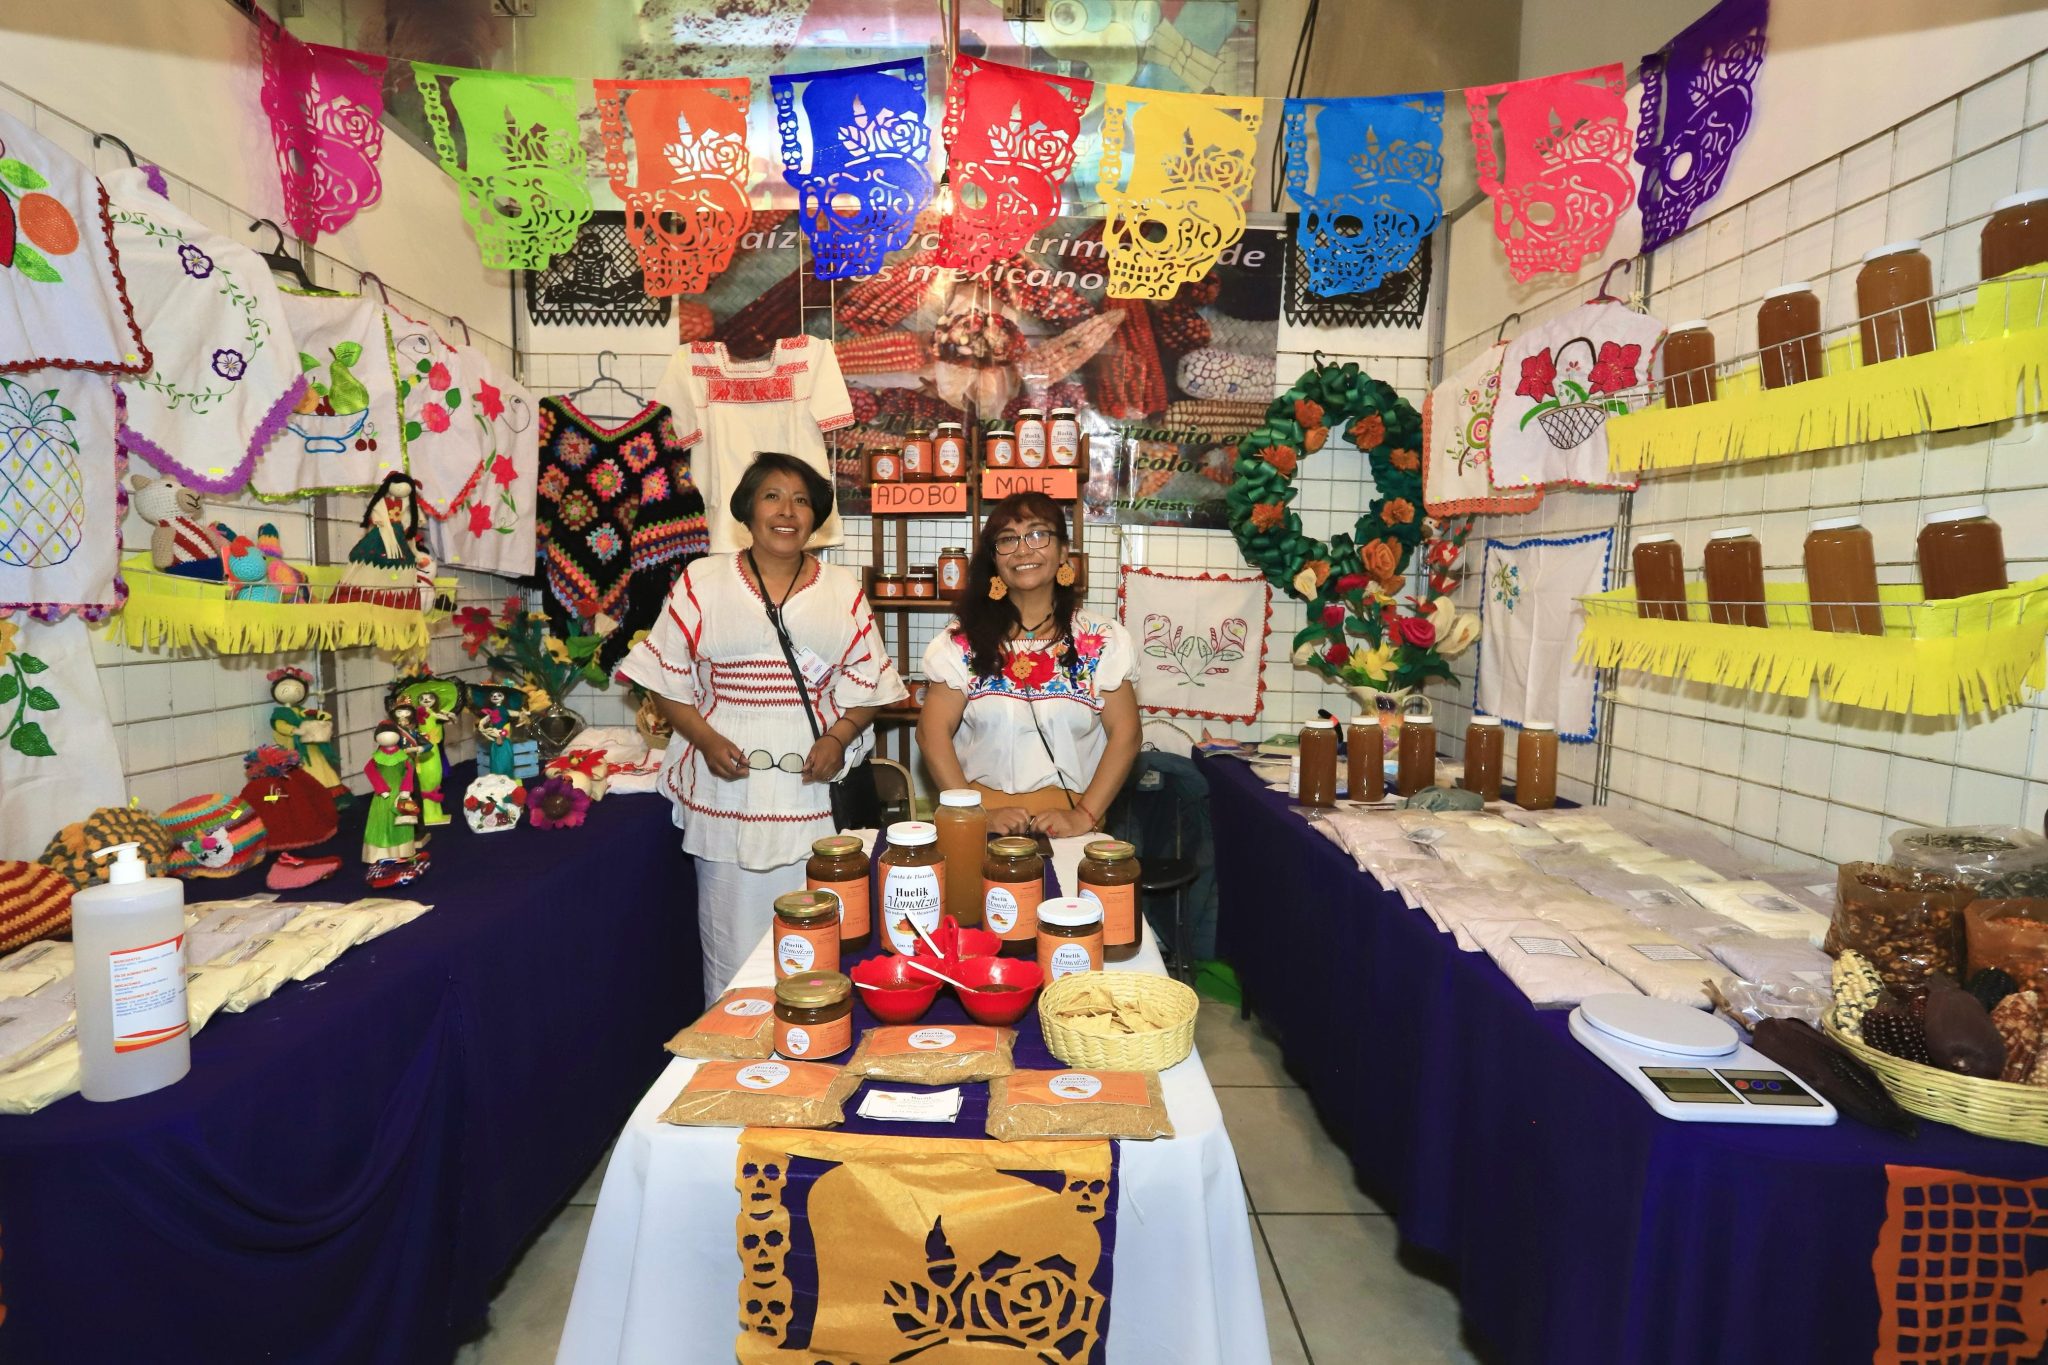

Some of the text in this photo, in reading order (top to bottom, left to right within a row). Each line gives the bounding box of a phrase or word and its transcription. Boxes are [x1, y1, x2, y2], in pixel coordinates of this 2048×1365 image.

[741, 224, 798, 250] aíz
[1217, 242, 1266, 269] de
[907, 259, 1106, 290] mexicano
[1134, 453, 1209, 474] color
[877, 485, 957, 506] ADOBO
[995, 475, 1055, 496] MOLE
[895, 887, 929, 898] Huelik
